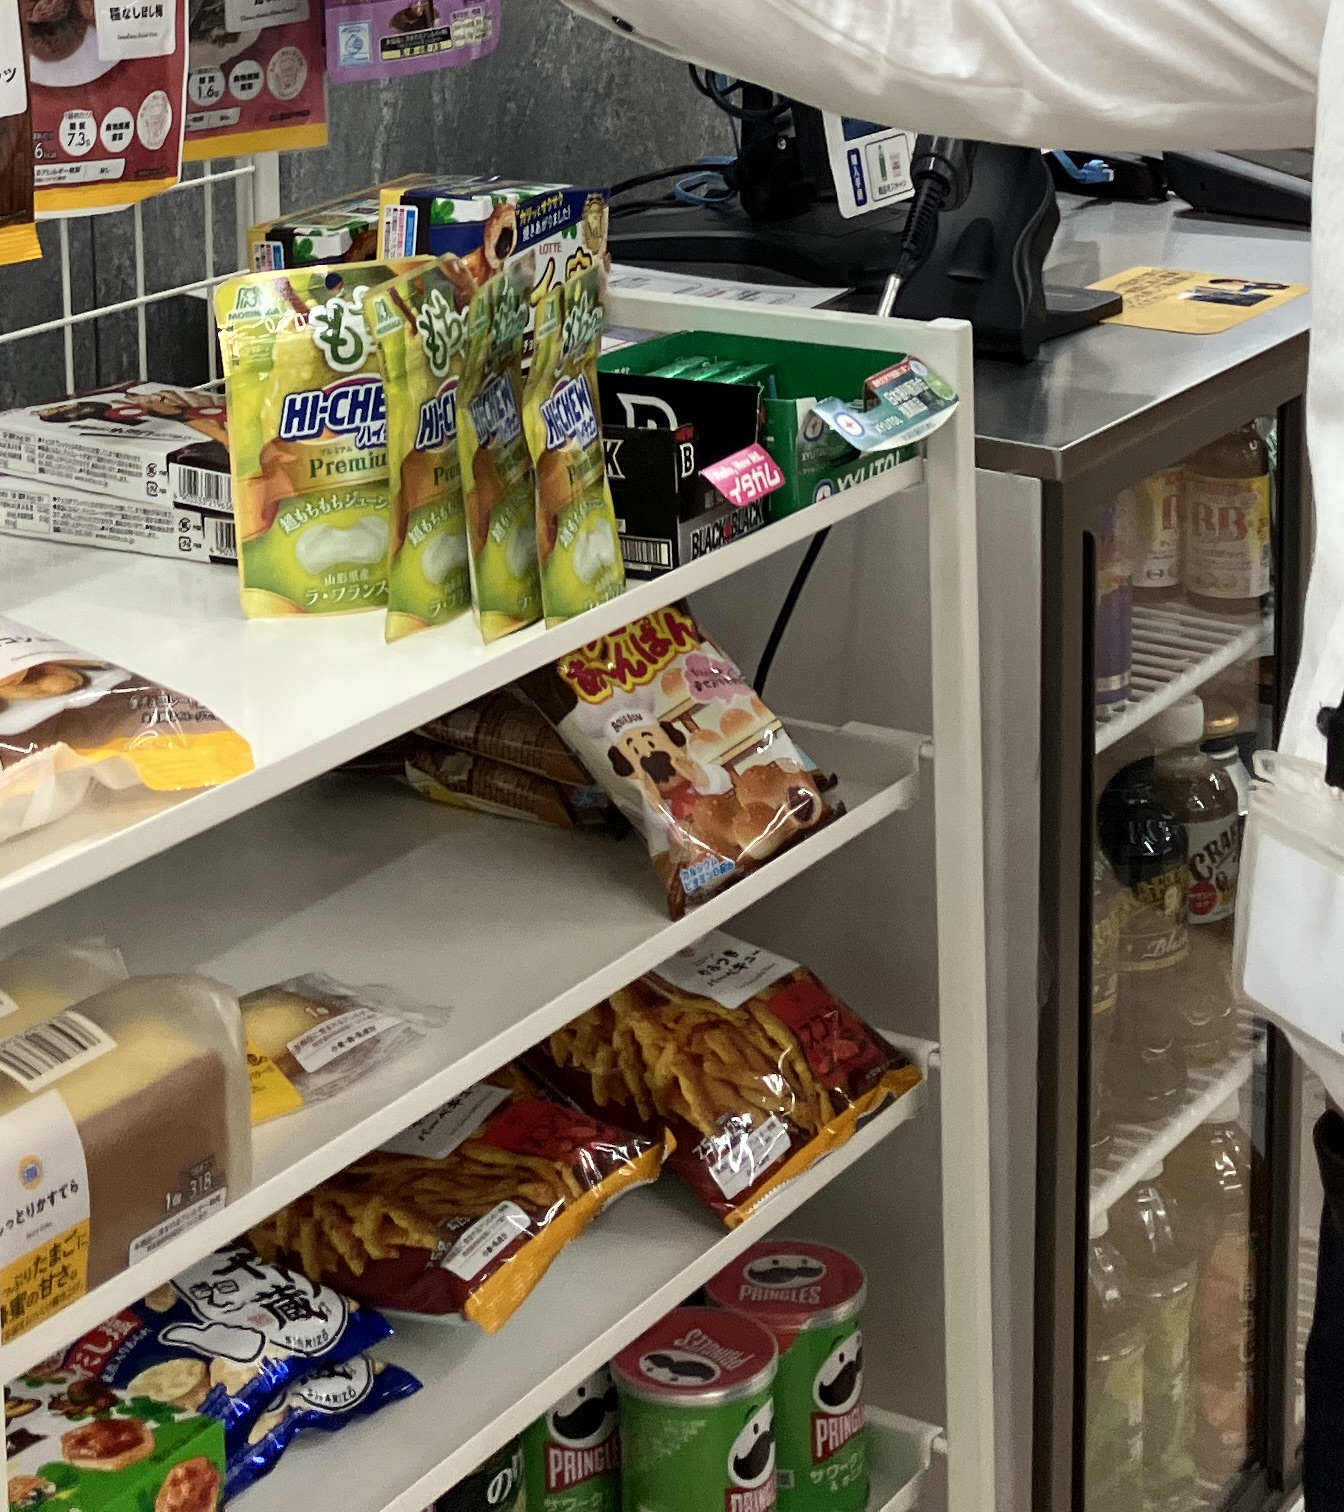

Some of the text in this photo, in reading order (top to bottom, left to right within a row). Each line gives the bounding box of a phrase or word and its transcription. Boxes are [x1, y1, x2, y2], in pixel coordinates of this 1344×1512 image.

[538, 242, 562, 255] LOTTE
[565, 611, 695, 697] あんぱん
[738, 1285, 822, 1306] PRINGLES
